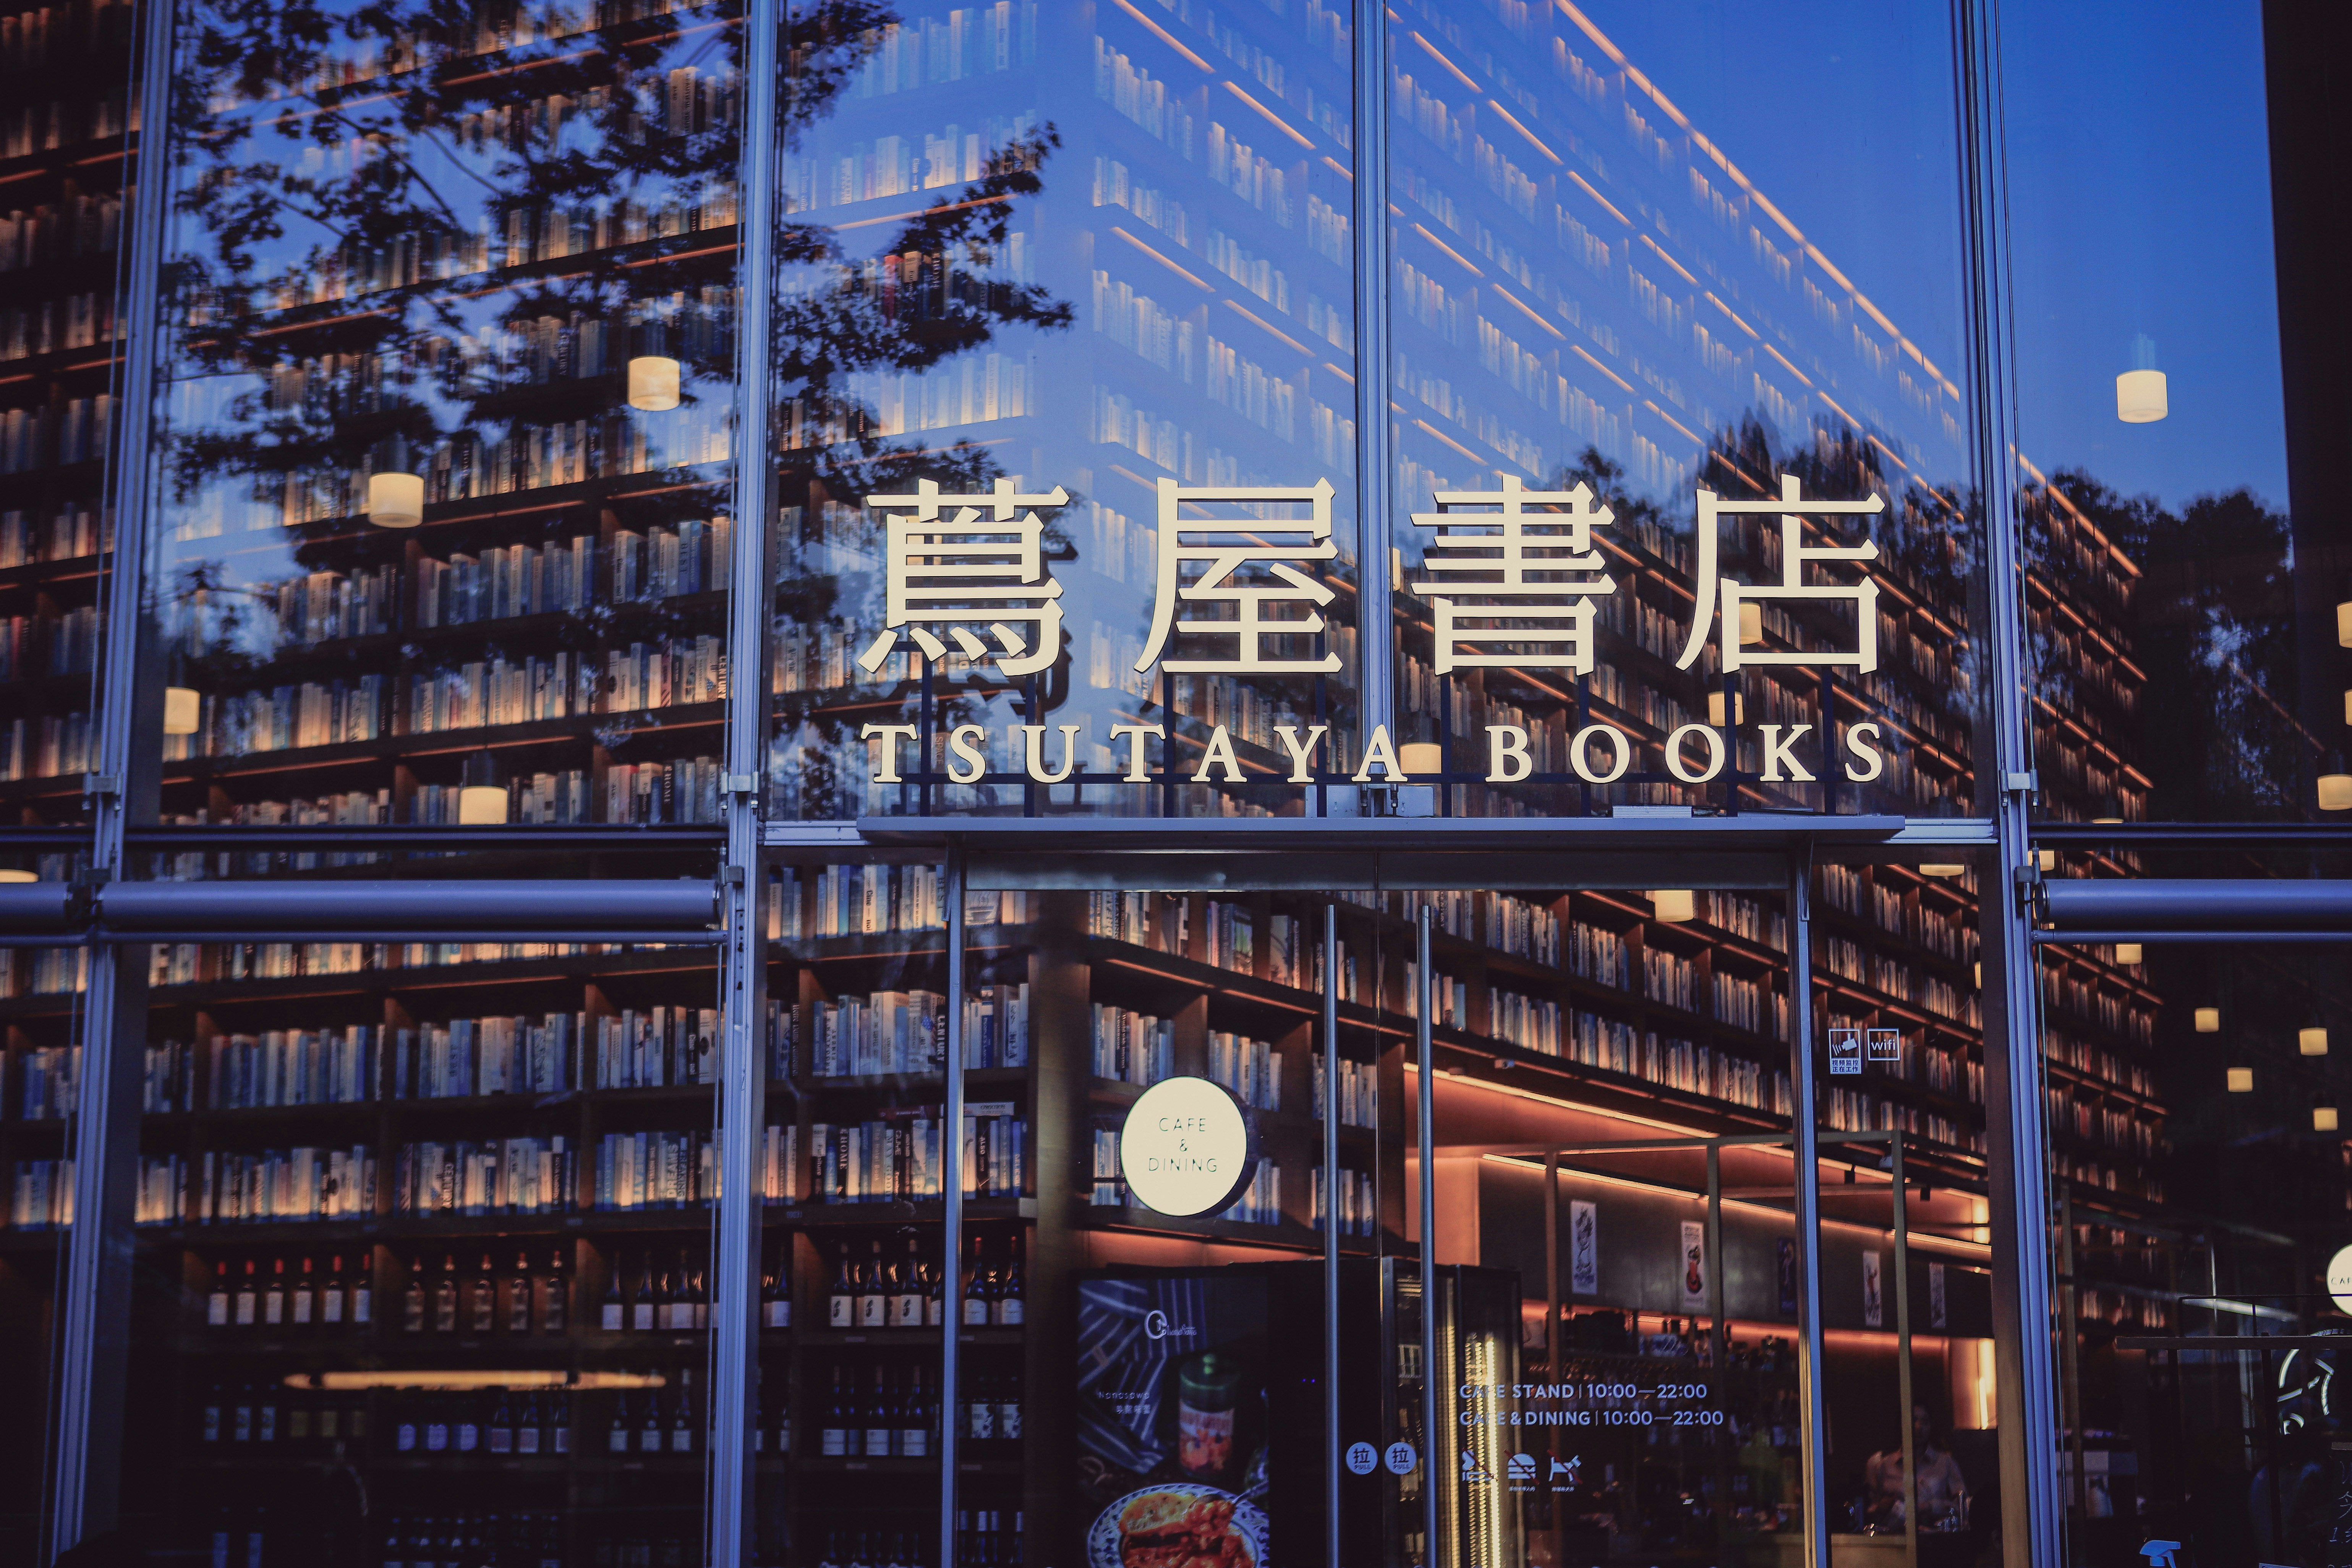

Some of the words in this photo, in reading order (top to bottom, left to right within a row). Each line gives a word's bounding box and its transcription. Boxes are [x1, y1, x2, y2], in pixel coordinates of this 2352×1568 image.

[858, 473, 1885, 676] 蔦屋書店
[860, 723, 1408, 783] TSUTAYA
[1484, 723, 1882, 783] BOOKS
[1871, 1038, 1896, 1050] wifi
[1159, 1118, 1206, 1132] CAFE
[839, 1136, 847, 1170] HOME
[1179, 1139, 1188, 1152] &
[1149, 1158, 1217, 1172] DINING
[1512, 1383, 1575, 1399] STAND
[1510, 1411, 1522, 1426] &
[1525, 1411, 1591, 1426] DINING
[1354, 1447, 1370, 1463] 拉
[1393, 1447, 1409, 1463] 拉
